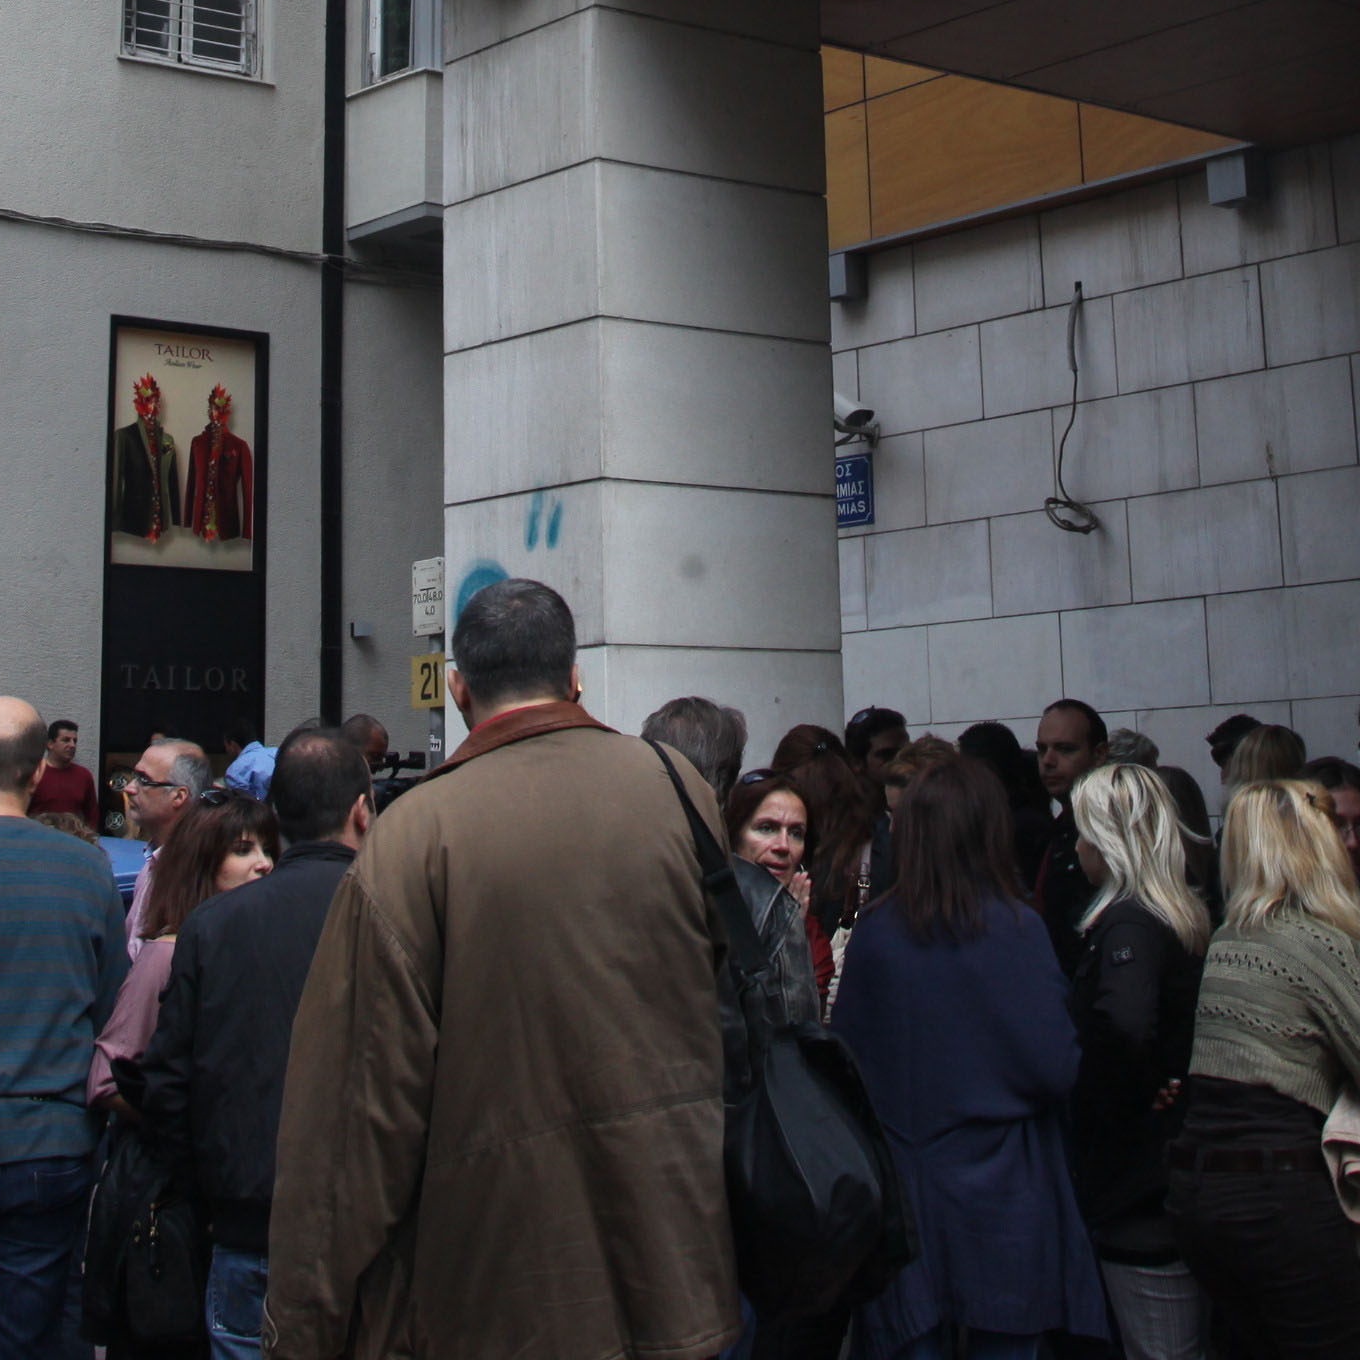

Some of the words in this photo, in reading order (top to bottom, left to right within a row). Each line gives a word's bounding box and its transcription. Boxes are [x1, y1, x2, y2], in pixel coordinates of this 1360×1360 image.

[154, 343, 214, 362] TAILOR
[836, 464, 852, 478] ΟΣ
[838, 501, 866, 516] MIAS
[120, 664, 249, 692] TAILOR
[421, 661, 438, 700] 21
